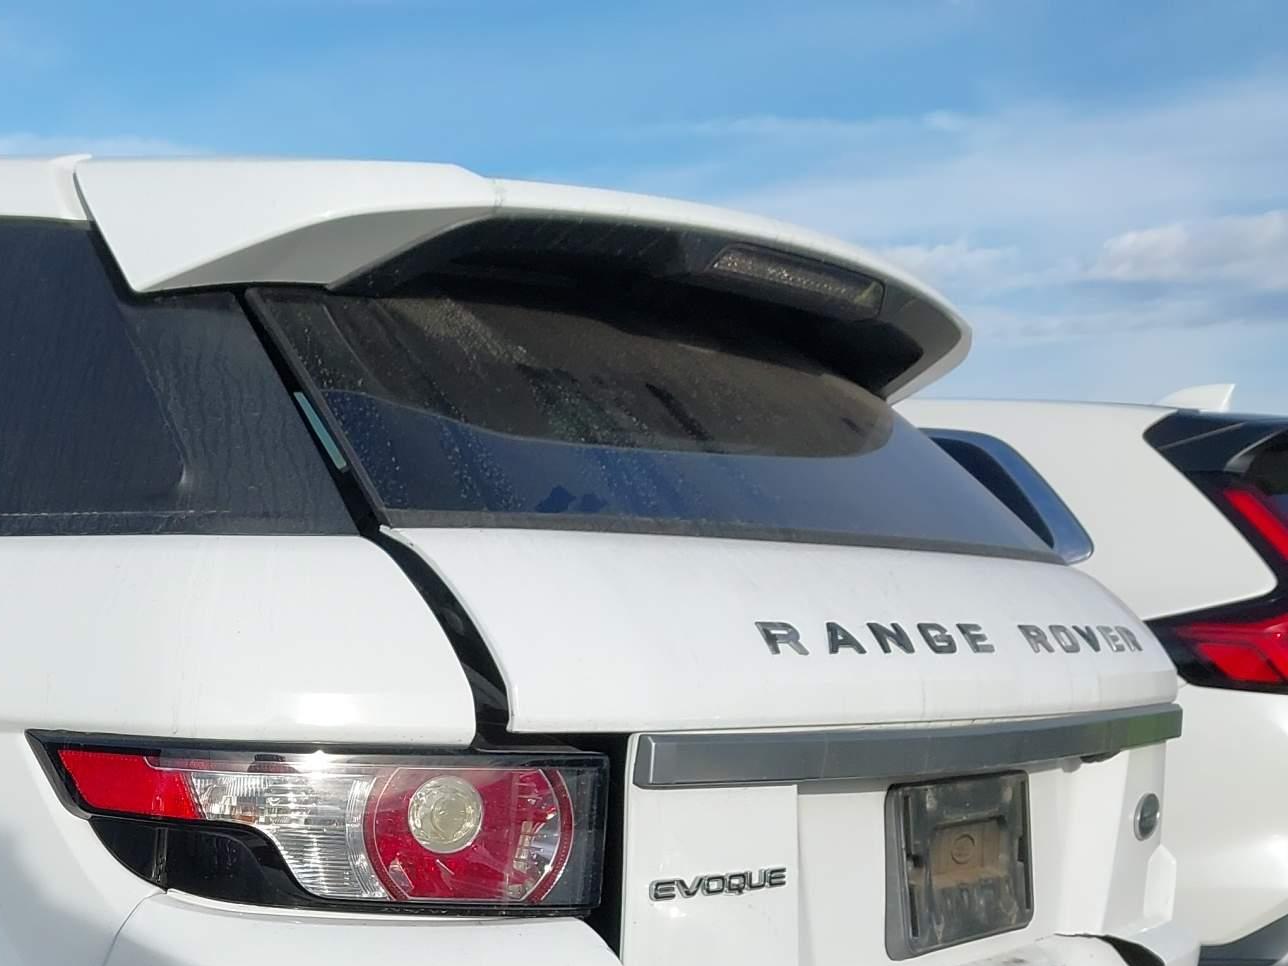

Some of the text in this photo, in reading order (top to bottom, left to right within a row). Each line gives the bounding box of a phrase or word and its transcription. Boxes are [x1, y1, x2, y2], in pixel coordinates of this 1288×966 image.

[754, 621, 1144, 656] RANGE ROVER
[649, 867, 787, 902] EVOQUE
